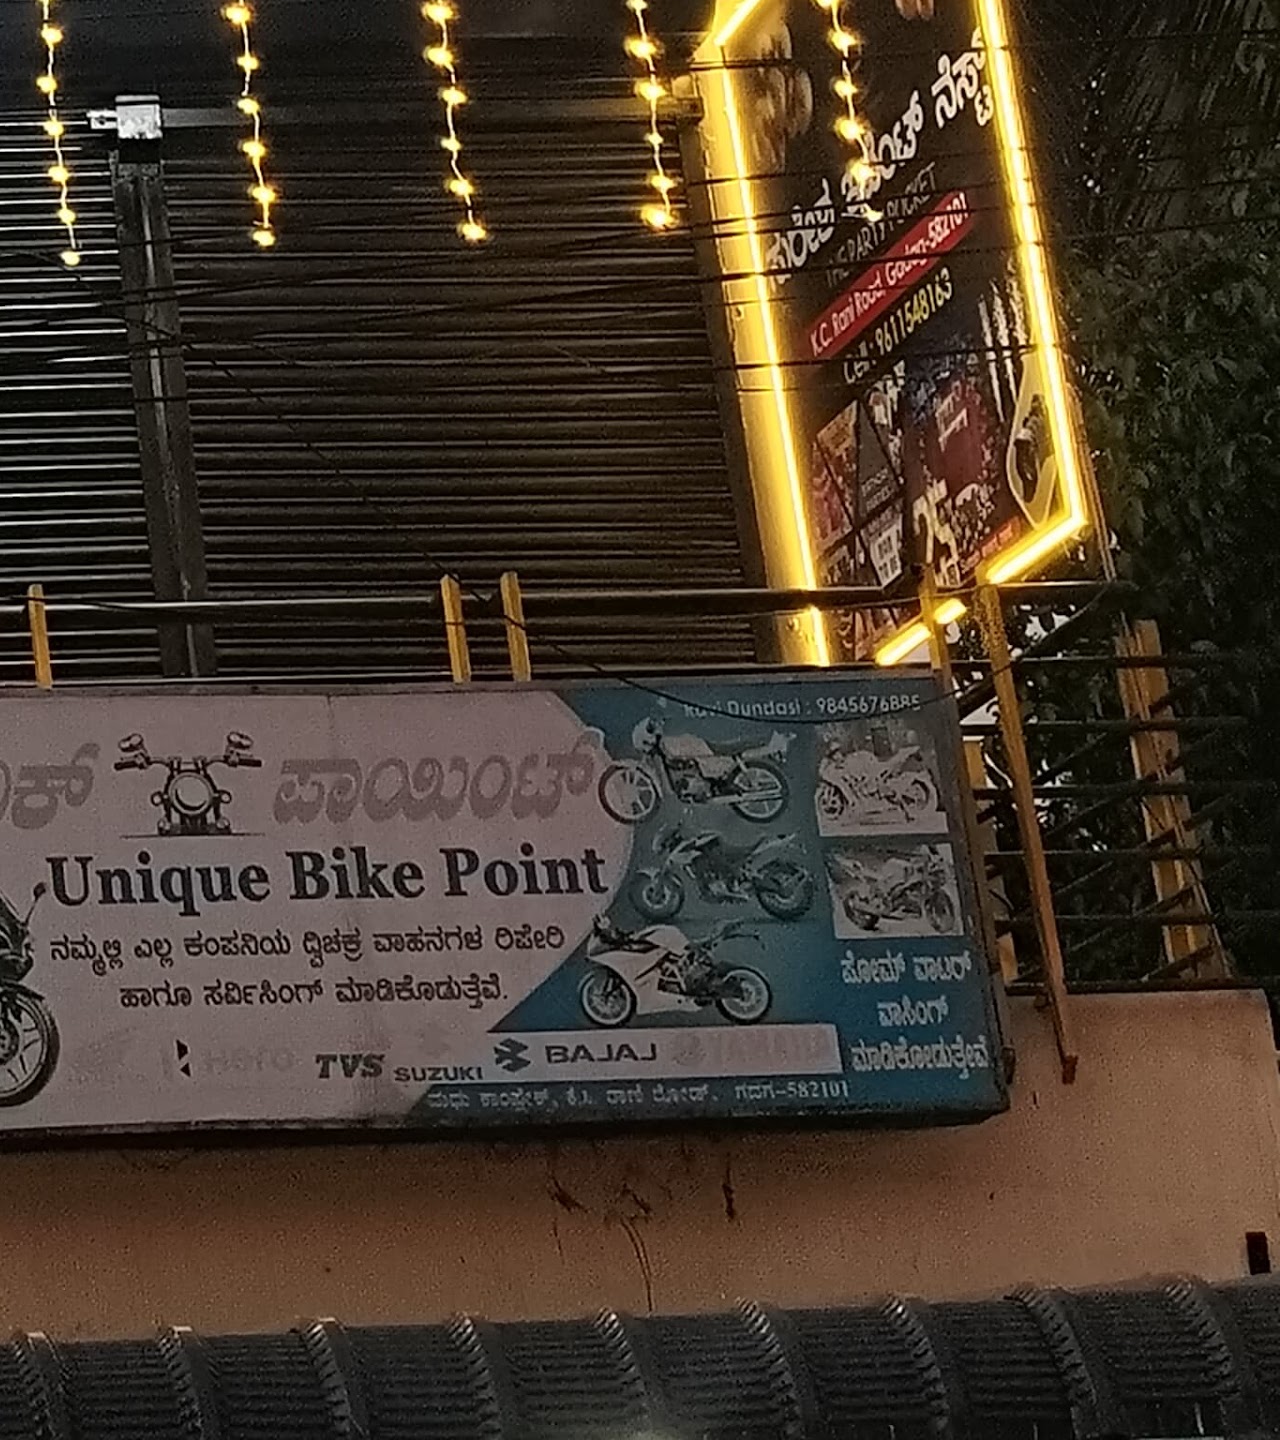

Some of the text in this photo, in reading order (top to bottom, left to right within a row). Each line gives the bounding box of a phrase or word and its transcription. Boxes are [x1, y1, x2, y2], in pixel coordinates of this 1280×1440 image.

[46, 842, 609, 917] Unique Bike Point
[183, 929, 293, 958] ಕಂಪನಿಯ
[372, 925, 483, 953] ವಾಹನಗಳ
[495, 923, 566, 951] ರಿಪೇರಿ
[119, 981, 192, 1009] ಹಾಗೂ
[316, 1054, 386, 1079] TVS
[394, 1067, 484, 1082] SUZUKI
[545, 1042, 658, 1063] BAJAJ
